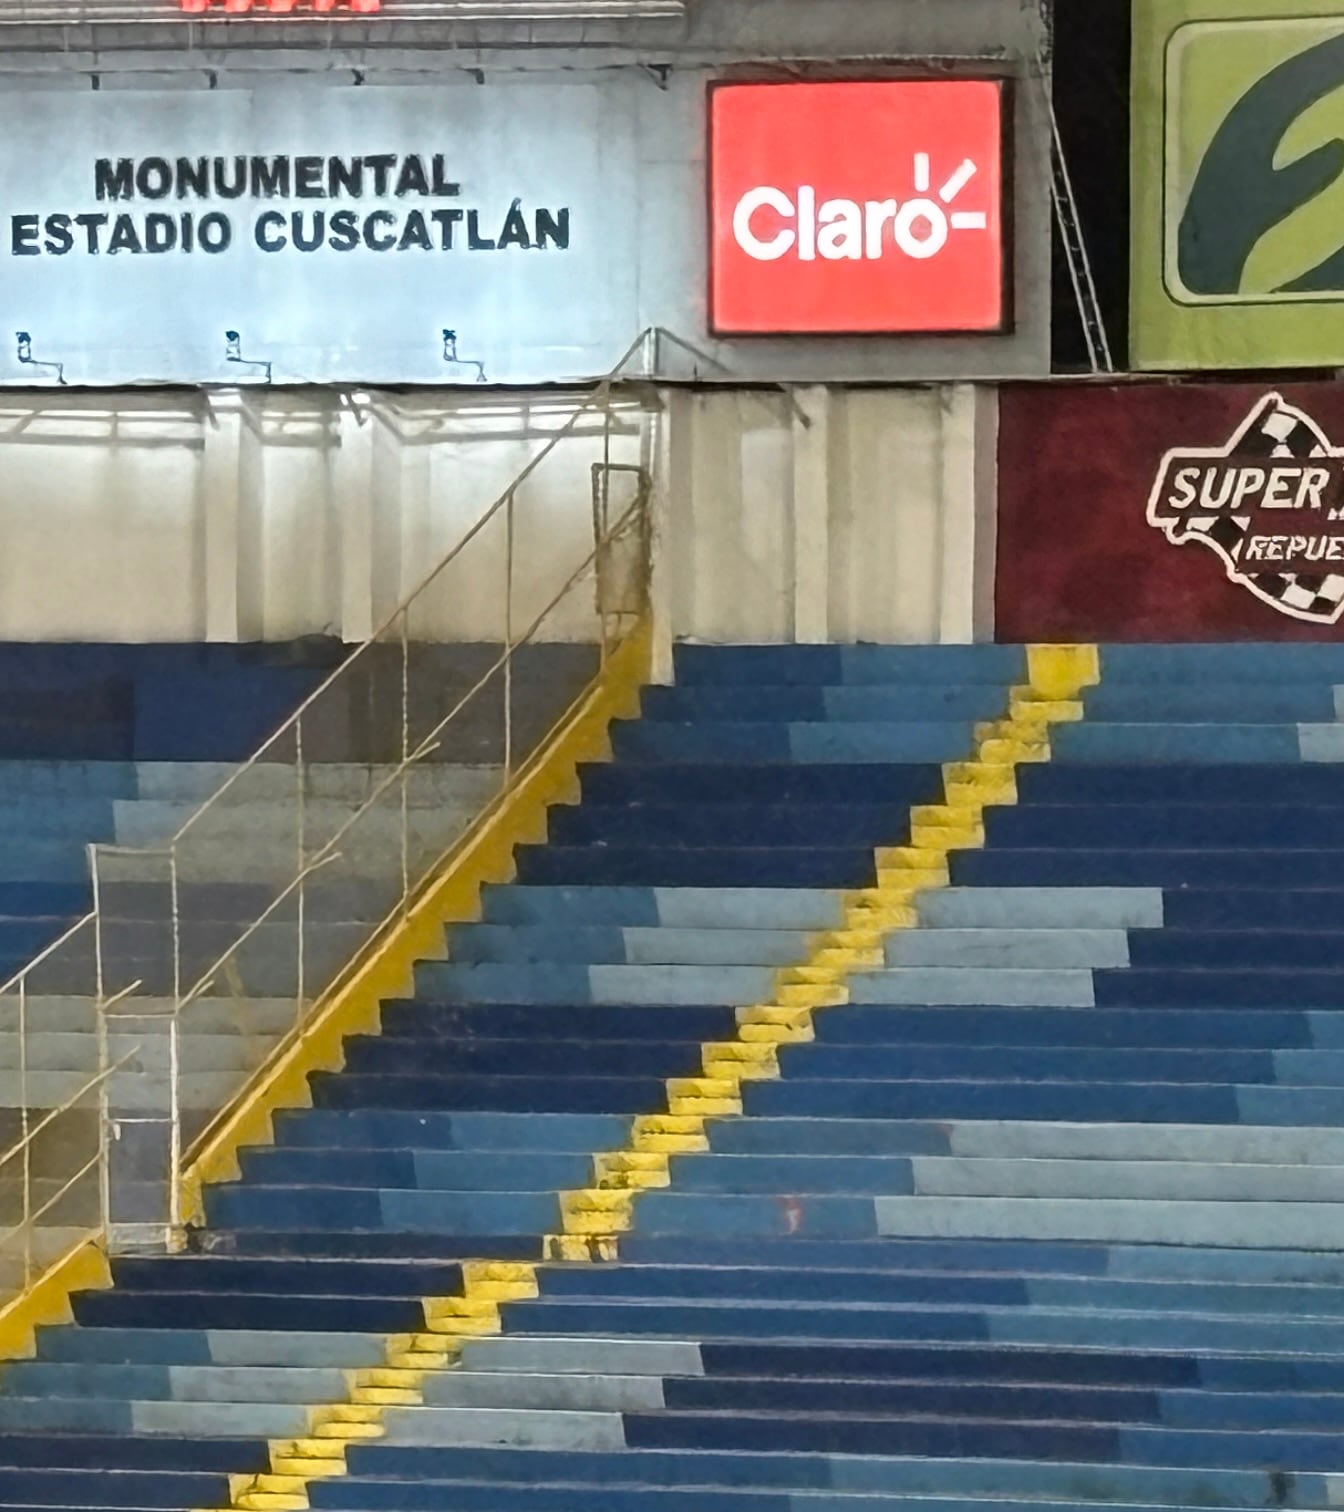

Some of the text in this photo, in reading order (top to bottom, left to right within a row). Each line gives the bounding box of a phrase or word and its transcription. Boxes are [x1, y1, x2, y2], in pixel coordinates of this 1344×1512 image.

[95, 153, 460, 200] MONUMENTAL
[10, 198, 570, 256] ESTADIO CUSCATLÁN
[732, 186, 946, 262] Claro
[1165, 466, 1333, 513] SUPER
